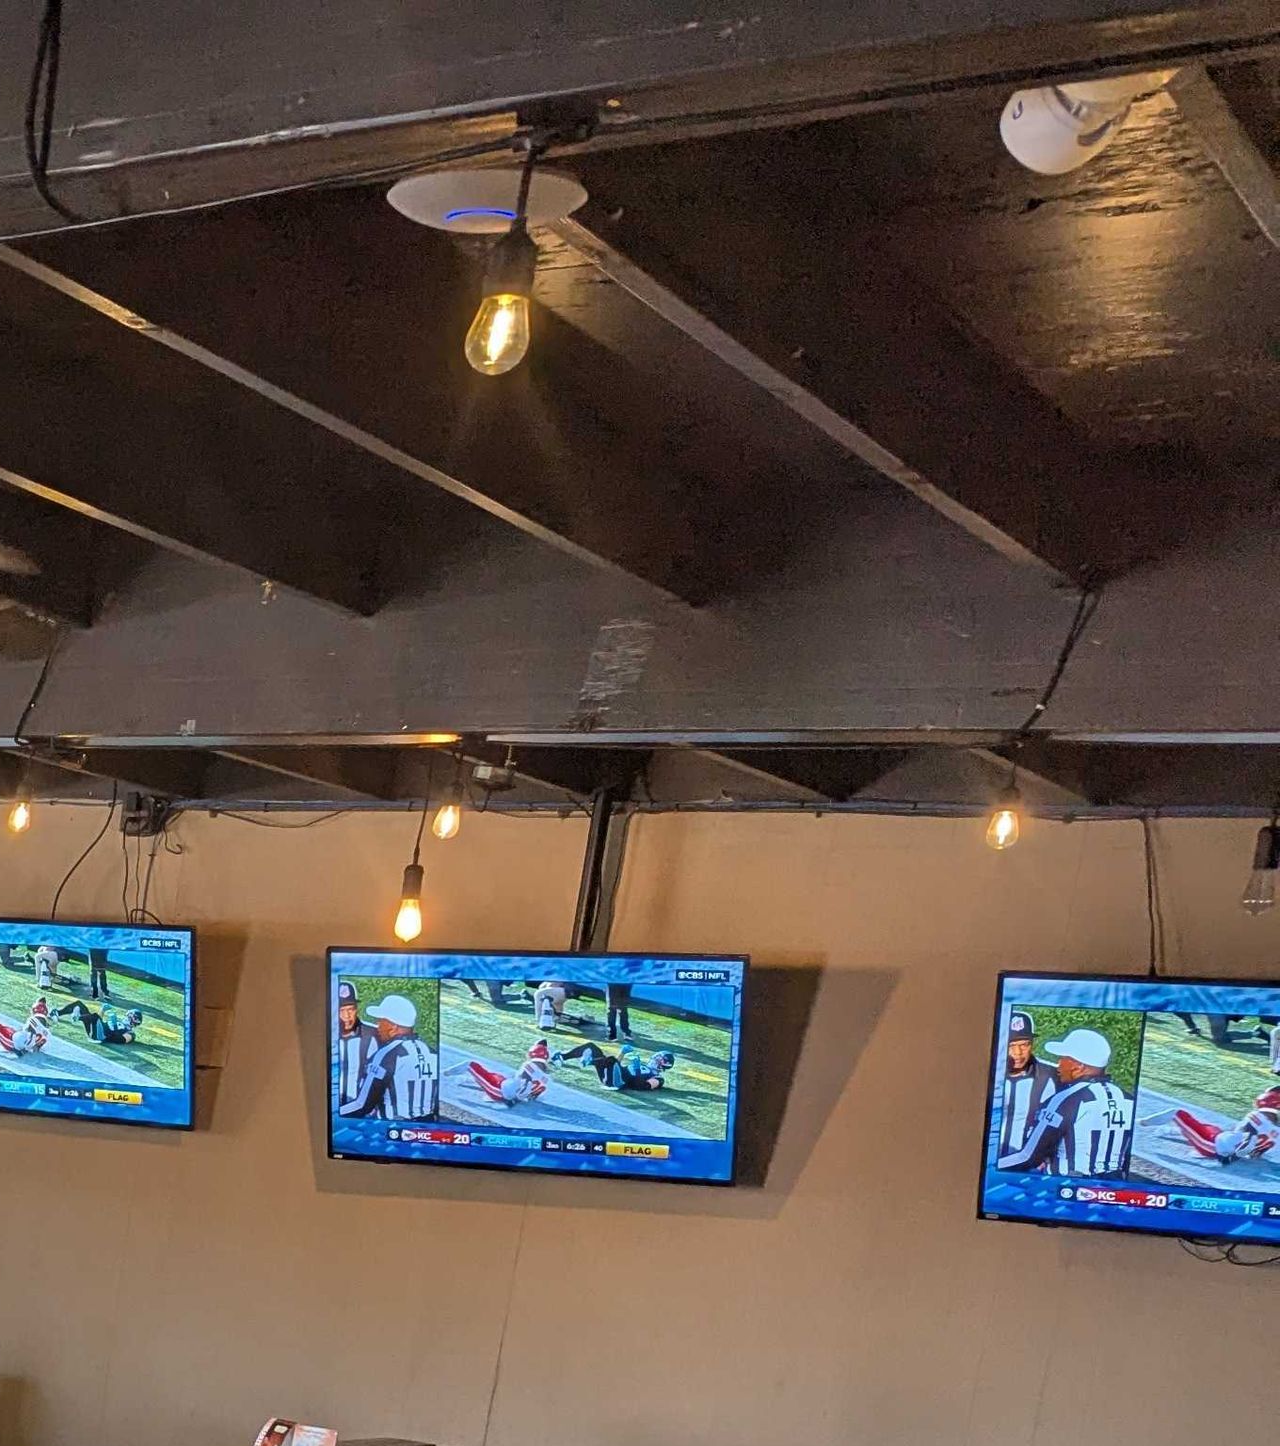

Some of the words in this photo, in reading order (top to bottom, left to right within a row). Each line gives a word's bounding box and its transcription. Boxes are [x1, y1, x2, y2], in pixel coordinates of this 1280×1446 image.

[708, 972, 726, 980] NFL
[414, 1063, 433, 1079] 14
[107, 1093, 128, 1102] FLAG
[1102, 1110, 1126, 1128] 14
[417, 1131, 431, 1140] KC
[453, 1133, 469, 1144] 20
[528, 1139, 541, 1149] 15
[623, 1146, 651, 1156] FLAG
[1097, 1190, 1116, 1201] KC
[1145, 1194, 1167, 1208] 20
[1191, 1199, 1218, 1210] CAR
[1243, 1203, 1261, 1215] 15
